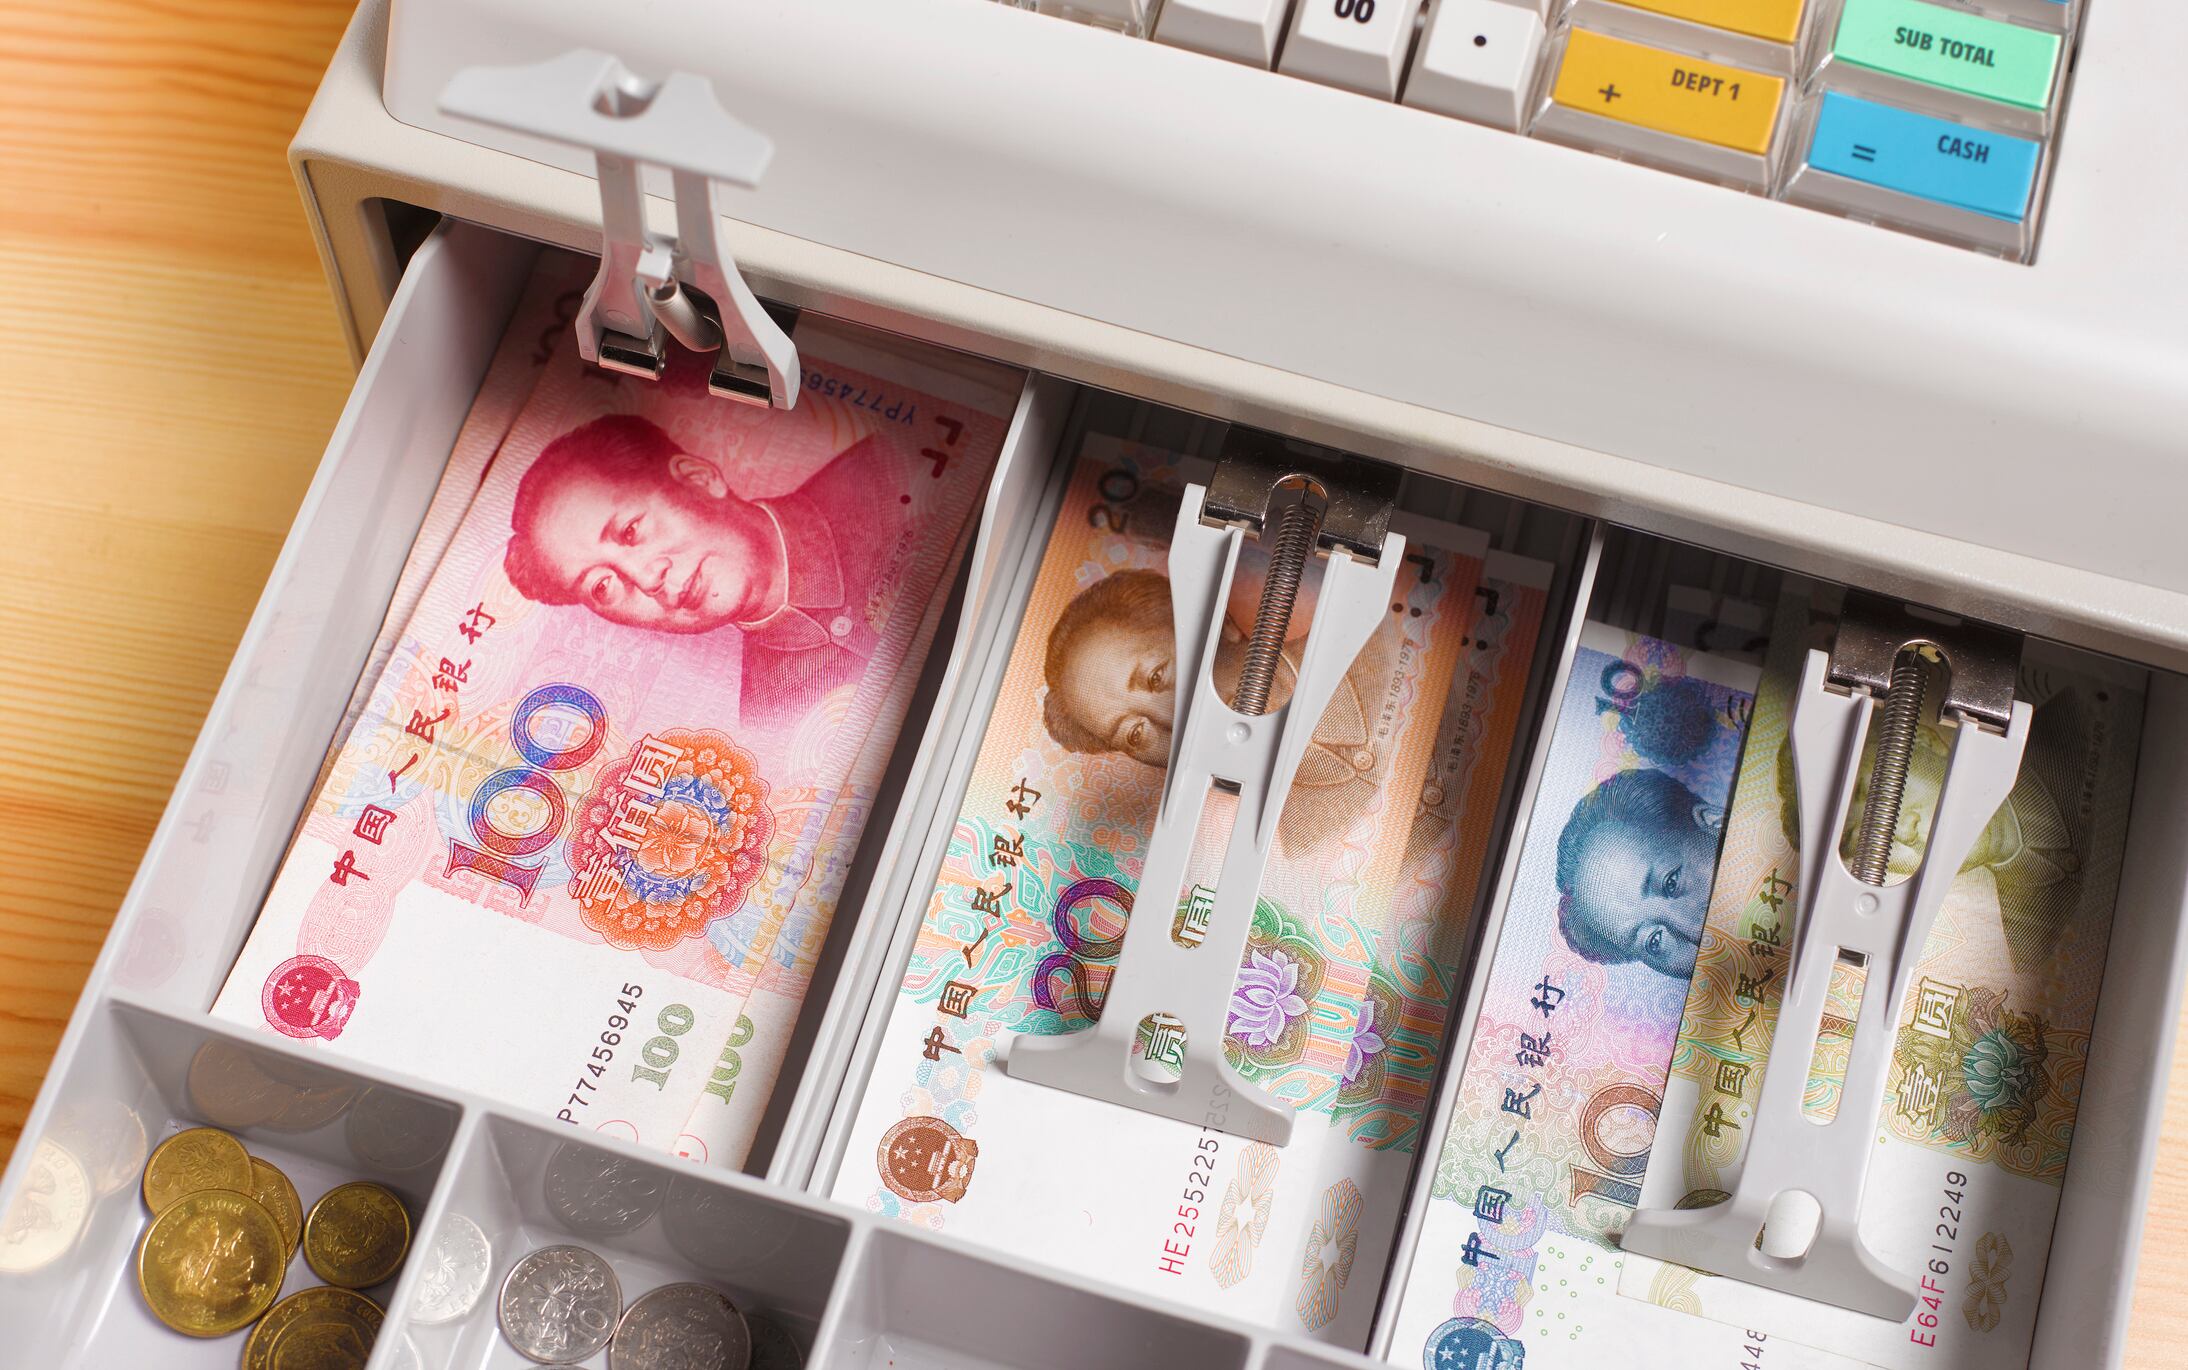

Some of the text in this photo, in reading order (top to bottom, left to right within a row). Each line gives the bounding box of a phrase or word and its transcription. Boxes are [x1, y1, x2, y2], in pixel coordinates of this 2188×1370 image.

[1671, 68, 1741, 101] DEPT 1
[1894, 26, 1996, 68] SUB TOTAL
[1936, 134, 1990, 164] CASH
[1088, 467, 1140, 532] 20
[1594, 660, 1642, 724] 10
[443, 681, 609, 909] 100
[571, 733, 688, 915] 壹佰圆
[1031, 877, 1138, 1023] 20
[556, 981, 644, 1126] P77456945
[631, 1003, 695, 1092] 100
[704, 1013, 755, 1106] 100
[1569, 1083, 1662, 1209] 10
[514, 1252, 576, 1284] CENTS
[1910, 1170, 1968, 1350] E64F612249
